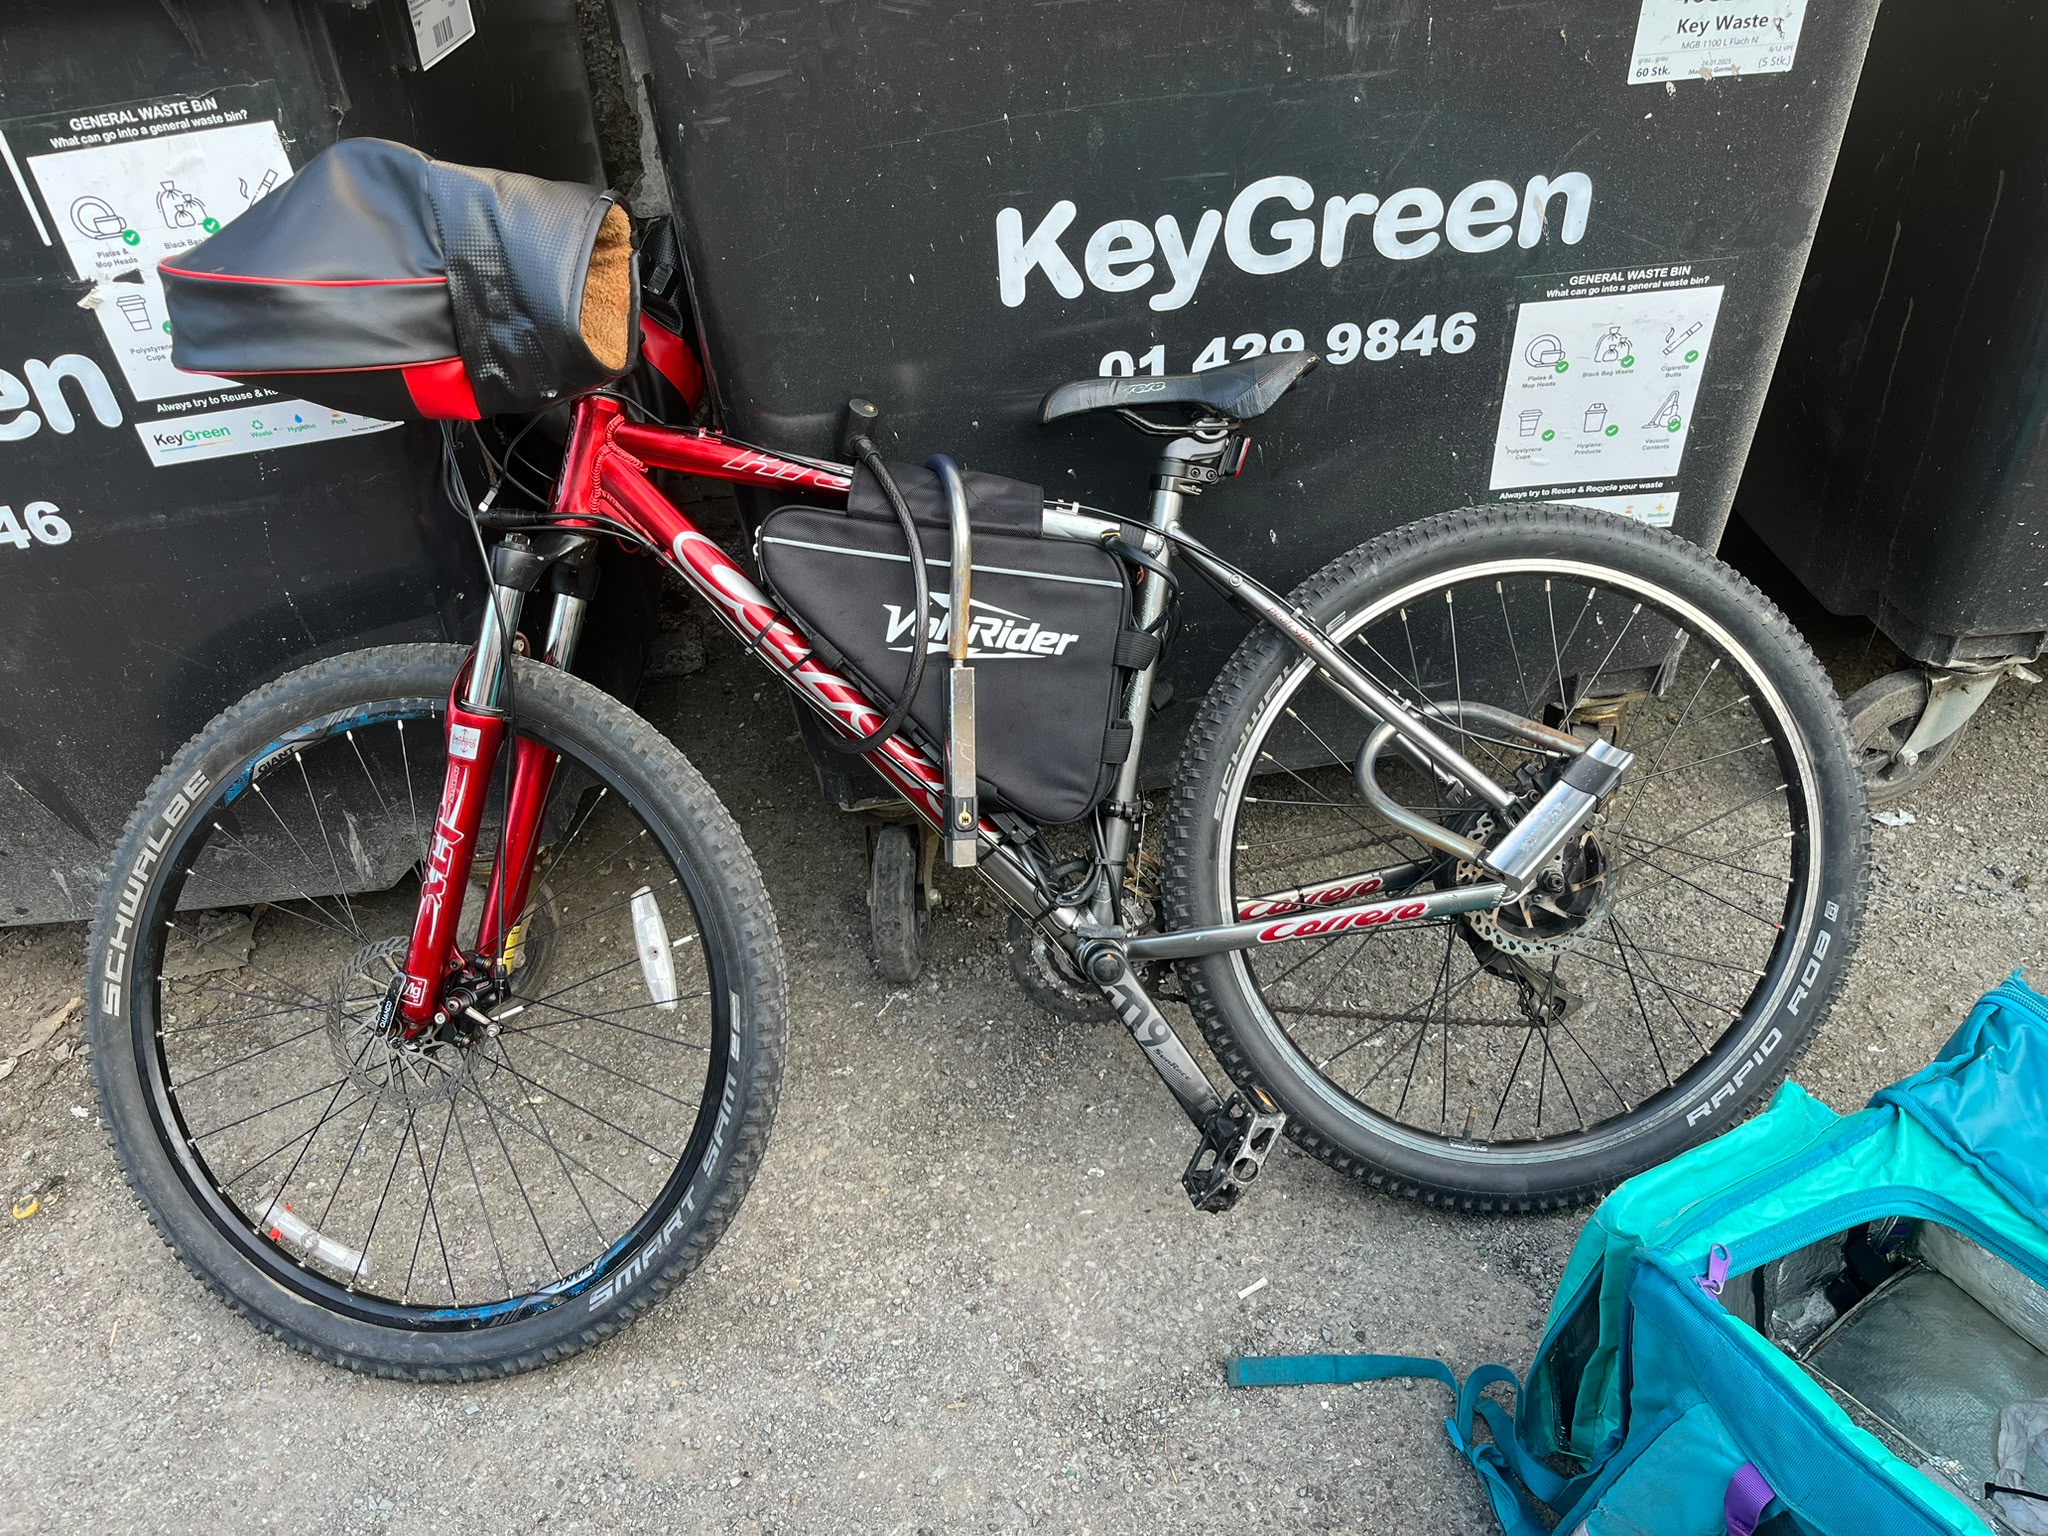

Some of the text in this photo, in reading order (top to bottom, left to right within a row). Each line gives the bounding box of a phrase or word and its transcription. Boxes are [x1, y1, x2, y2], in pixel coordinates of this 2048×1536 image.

[1677, 14, 1769, 37] Key Waste
[1681, 41, 1700, 50] MGB
[1703, 39, 1722, 48] 1100
[1729, 37, 1750, 46] Flach
[1636, 66, 1670, 77] 60 Stk.
[50, 109, 249, 149] What can go into a general waste bin?
[69, 110, 139, 132] GENERAL
[138, 100, 189, 121] WASTE
[96, 250, 121, 258] Plates
[164, 240, 186, 250] Black
[995, 171, 1594, 312] KeyGreen
[95, 257, 138, 269] Mop Heads
[1569, 265, 1692, 286] GENERAL WASTE BIN
[1546, 288, 1569, 298] What
[1588, 288, 1600, 296] go
[1601, 284, 1618, 293] into
[1626, 280, 1661, 293] general
[1662, 279, 1689, 288] waste
[1690, 276, 1710, 285] bin?
[1326, 310, 1478, 365] 9846
[156, 400, 192, 413] Always
[193, 397, 211, 408] try
[211, 395, 220, 405] to
[221, 392, 253, 402] Reuse
[254, 388, 264, 398] &
[153, 425, 231, 448] KeyGreen
[250, 430, 273, 438] Waste
[1499, 481, 1663, 500] Always try to Reuse & Recycle your waste
[0, 501, 72, 549] 46
[257, 745, 294, 774] GIANT
[101, 769, 212, 1017] SCHWALBE
[1238, 878, 1384, 921] Carrera
[1257, 902, 1428, 943] Carrera
[1786, 929, 1832, 1016] ROB
[379, 1000, 393, 1028] QUANDO
[1152, 1048, 1192, 1081] SunRace
[1685, 1027, 1784, 1127] RAPID
[588, 1072, 737, 1313] SMART SAM
[555, 1261, 596, 1290] GIANT
